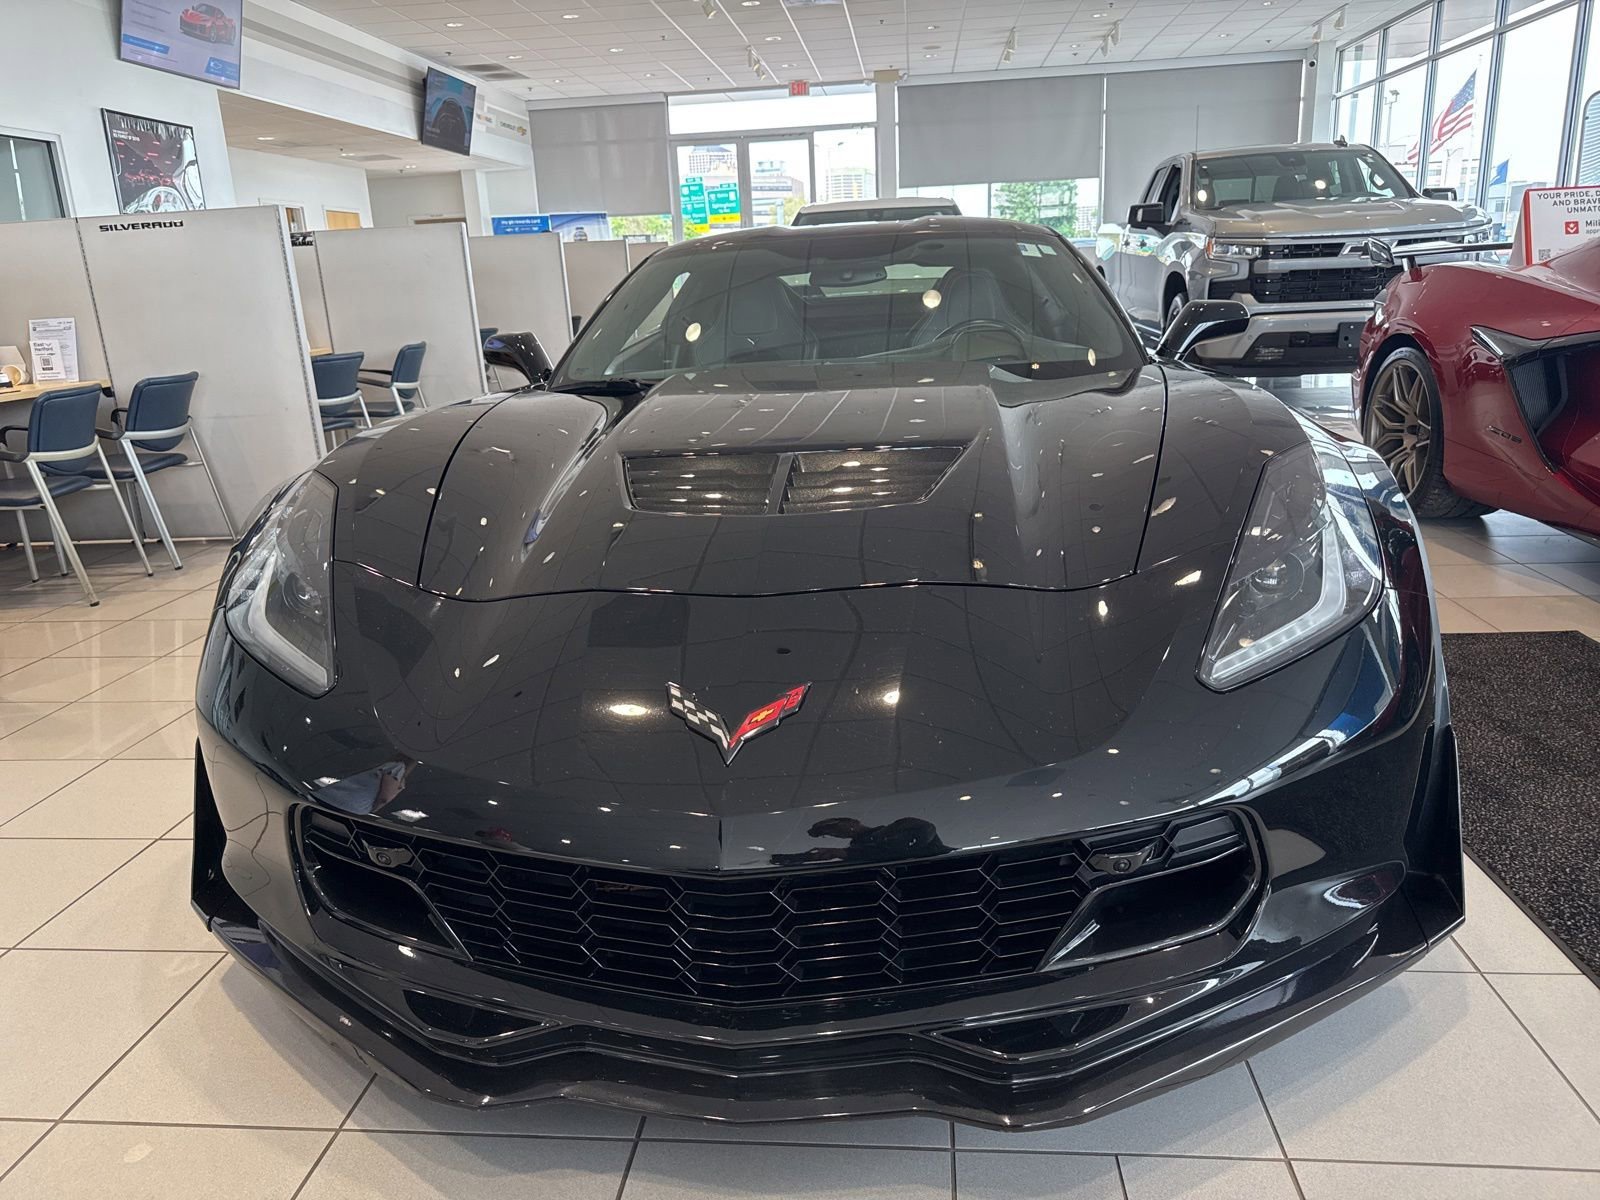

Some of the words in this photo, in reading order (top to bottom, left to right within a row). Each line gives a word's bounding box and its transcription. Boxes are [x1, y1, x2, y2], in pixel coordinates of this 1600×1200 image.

[791, 81, 808, 96] EXIT
[1552, 199, 1571, 207] AND
[99, 220, 184, 232] SILVERADO
